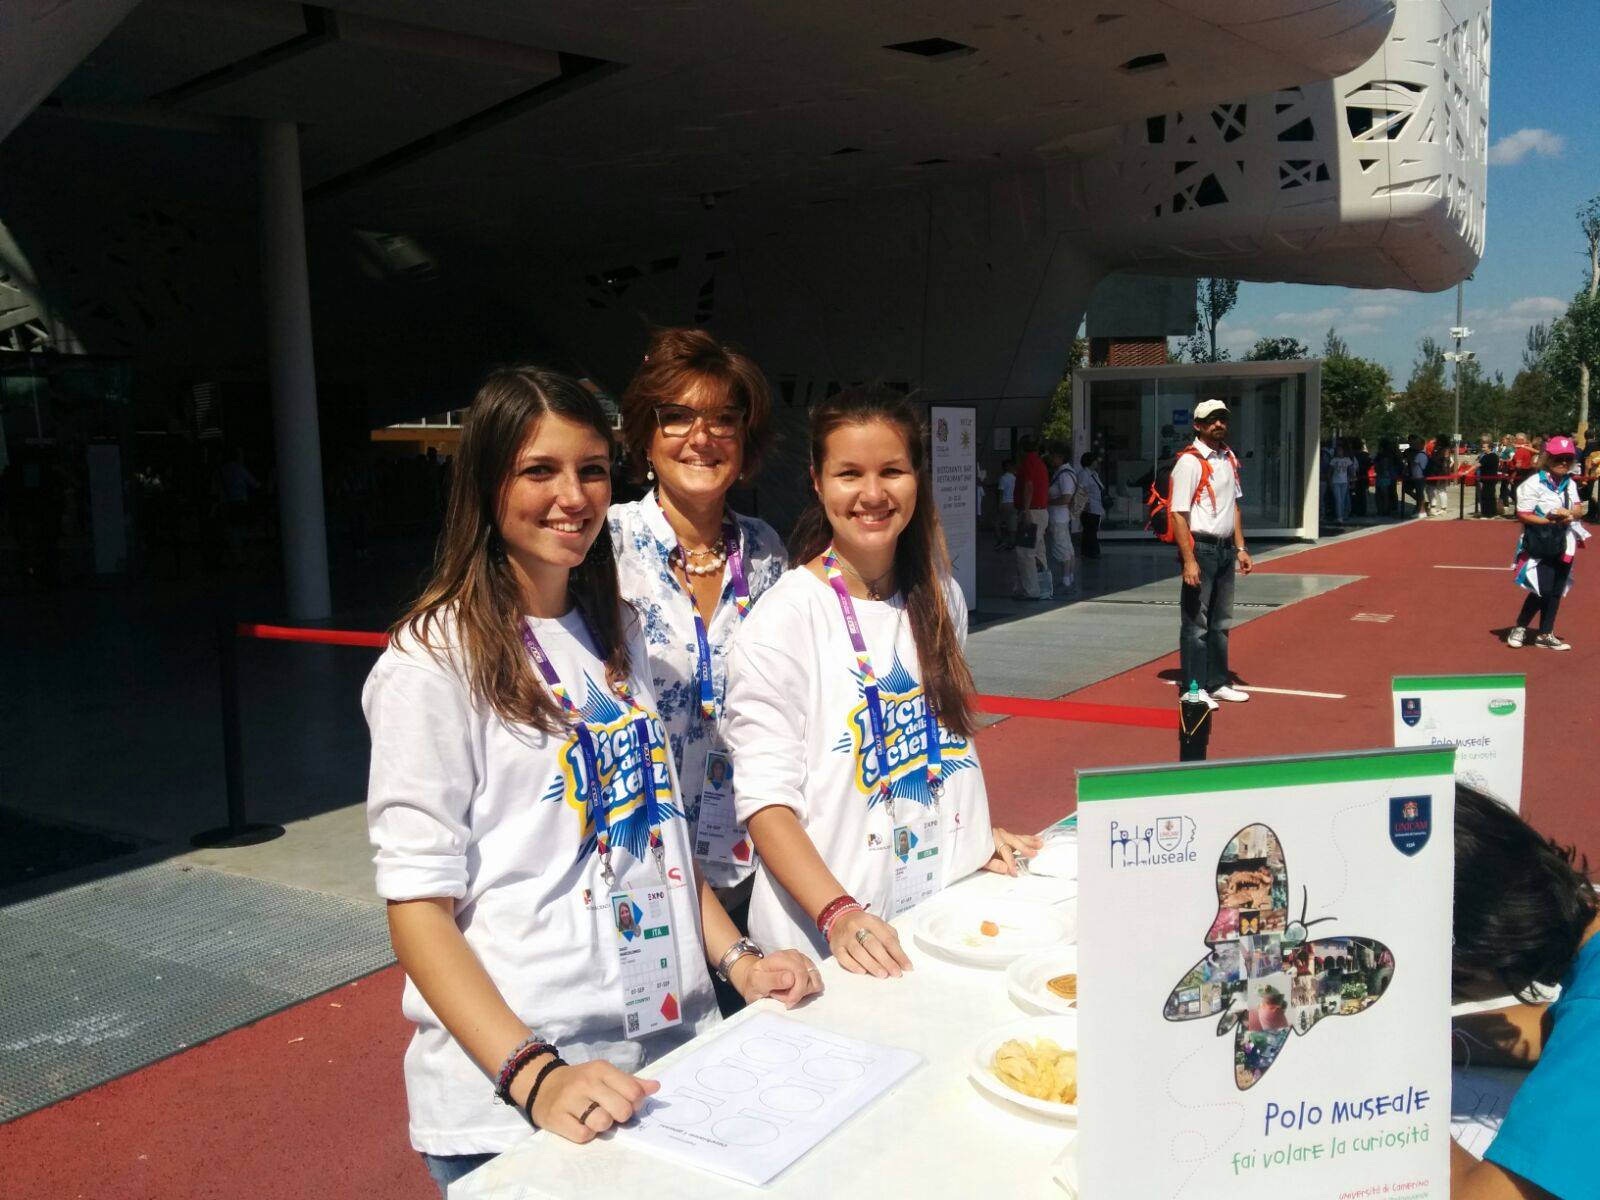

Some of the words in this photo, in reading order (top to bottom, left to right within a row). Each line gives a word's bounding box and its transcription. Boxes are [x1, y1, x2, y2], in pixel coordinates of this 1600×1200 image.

[1265, 1101, 1322, 1136] Polo
[1232, 1149, 1257, 1175] fai
[1331, 1137, 1346, 1158] la
[1353, 1123, 1429, 1152] curiosità
